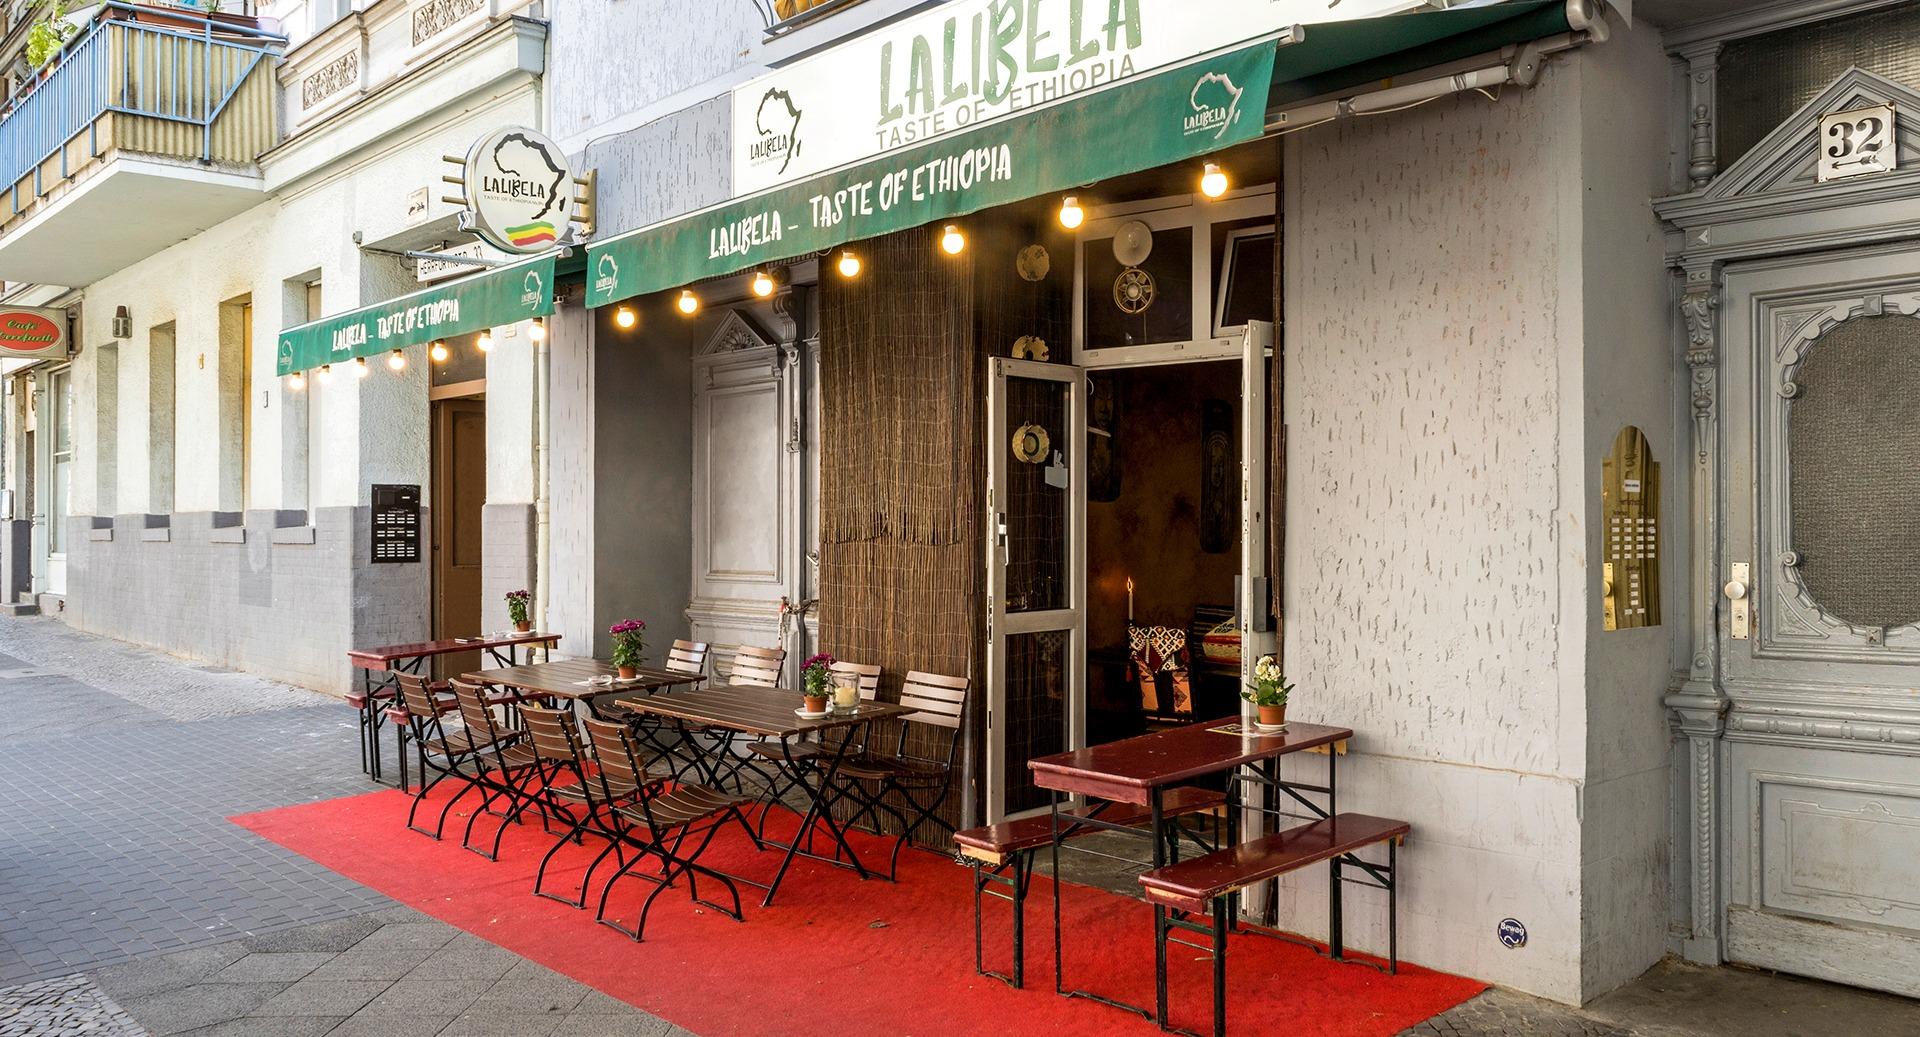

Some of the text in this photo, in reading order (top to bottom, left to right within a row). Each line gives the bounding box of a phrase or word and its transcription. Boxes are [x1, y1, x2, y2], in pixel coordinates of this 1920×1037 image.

[876, 0, 1142, 126] LALIBELA
[876, 54, 1136, 150] TASTE OF ETHIOPIA
[1184, 107, 1226, 130] LALIBELA
[750, 134, 787, 160] LALIBELA
[1828, 117, 1883, 158] 32
[483, 176, 545, 199] LALIBELA
[709, 210, 781, 259] LALIBELA
[809, 180, 873, 228] TASTE
[879, 168, 907, 211] OF
[911, 143, 1012, 201] ETHIOPIA
[332, 323, 367, 351] LALIBELA
[377, 311, 404, 339] TASTE
[405, 301, 418, 332] OF
[417, 299, 460, 328] ETHIOPIA
